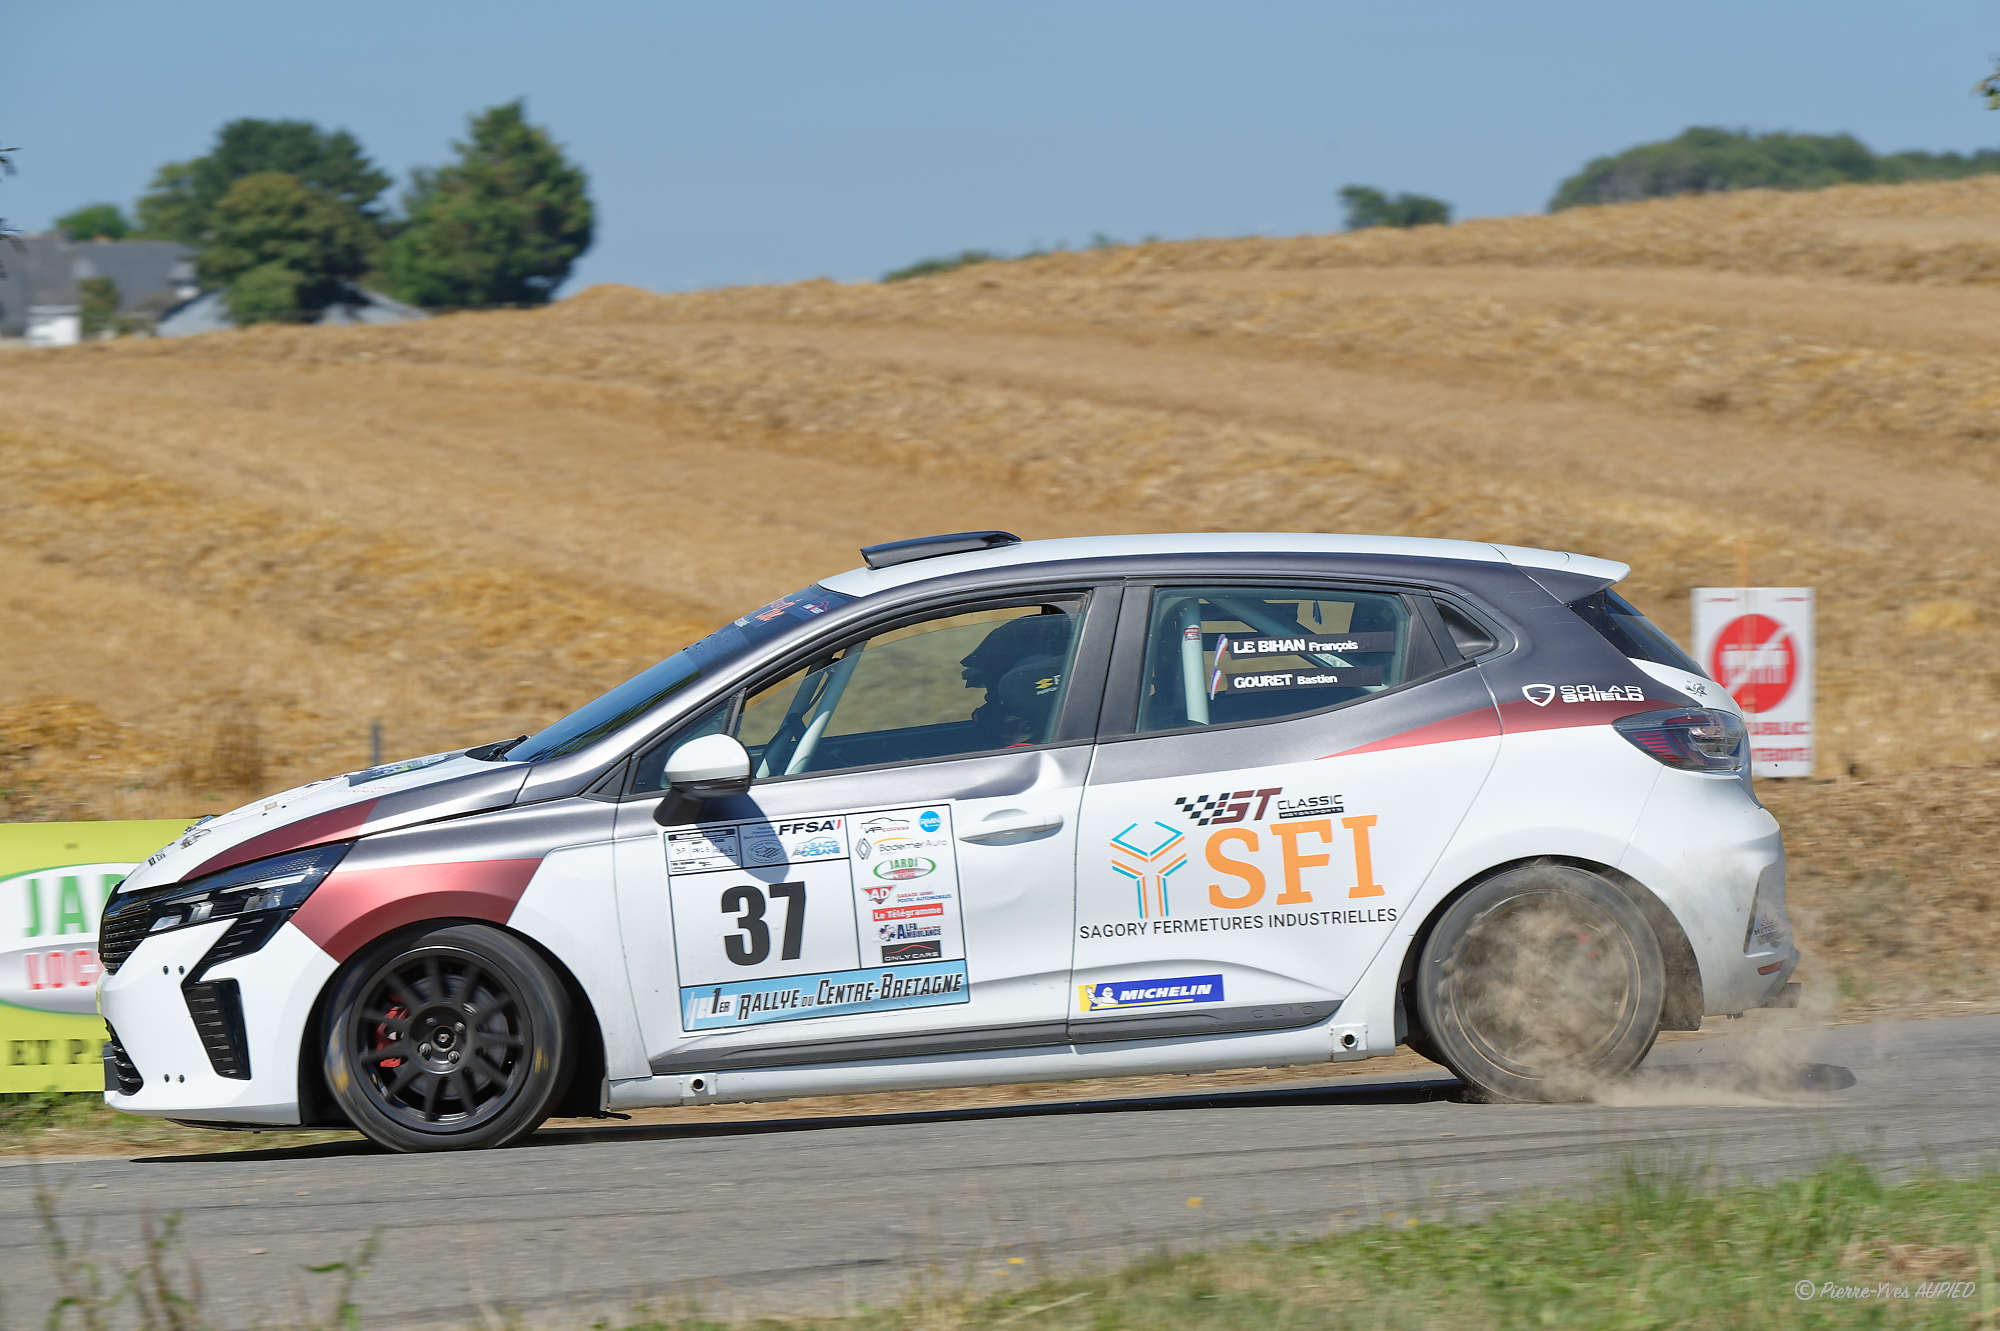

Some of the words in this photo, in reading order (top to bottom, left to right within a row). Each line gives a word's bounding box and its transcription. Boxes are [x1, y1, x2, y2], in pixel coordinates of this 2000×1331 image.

[1233, 641, 1256, 654] LE
[1258, 639, 1306, 653] BIHAN
[1309, 640, 1359, 653] François
[1234, 674, 1293, 689] GOURET
[1297, 675, 1338, 685] Bastien
[1560, 685, 1643, 694] SOLAR
[1562, 692, 1645, 703] SHIELD
[1277, 795, 1344, 810] CLASSIC
[778, 821, 834, 836] FFSA
[1205, 814, 1385, 910] SFI
[871, 887, 890, 900] AD
[874, 911, 886, 920] Le
[888, 907, 942, 919] Télégramme
[720, 880, 807, 967] 37
[1079, 922, 1147, 939] SAGORY
[1153, 915, 1263, 934] FERMETURES
[1268, 908, 1397, 928] INDUSTRIELLES
[1119, 983, 1213, 1001] MICHELIN
